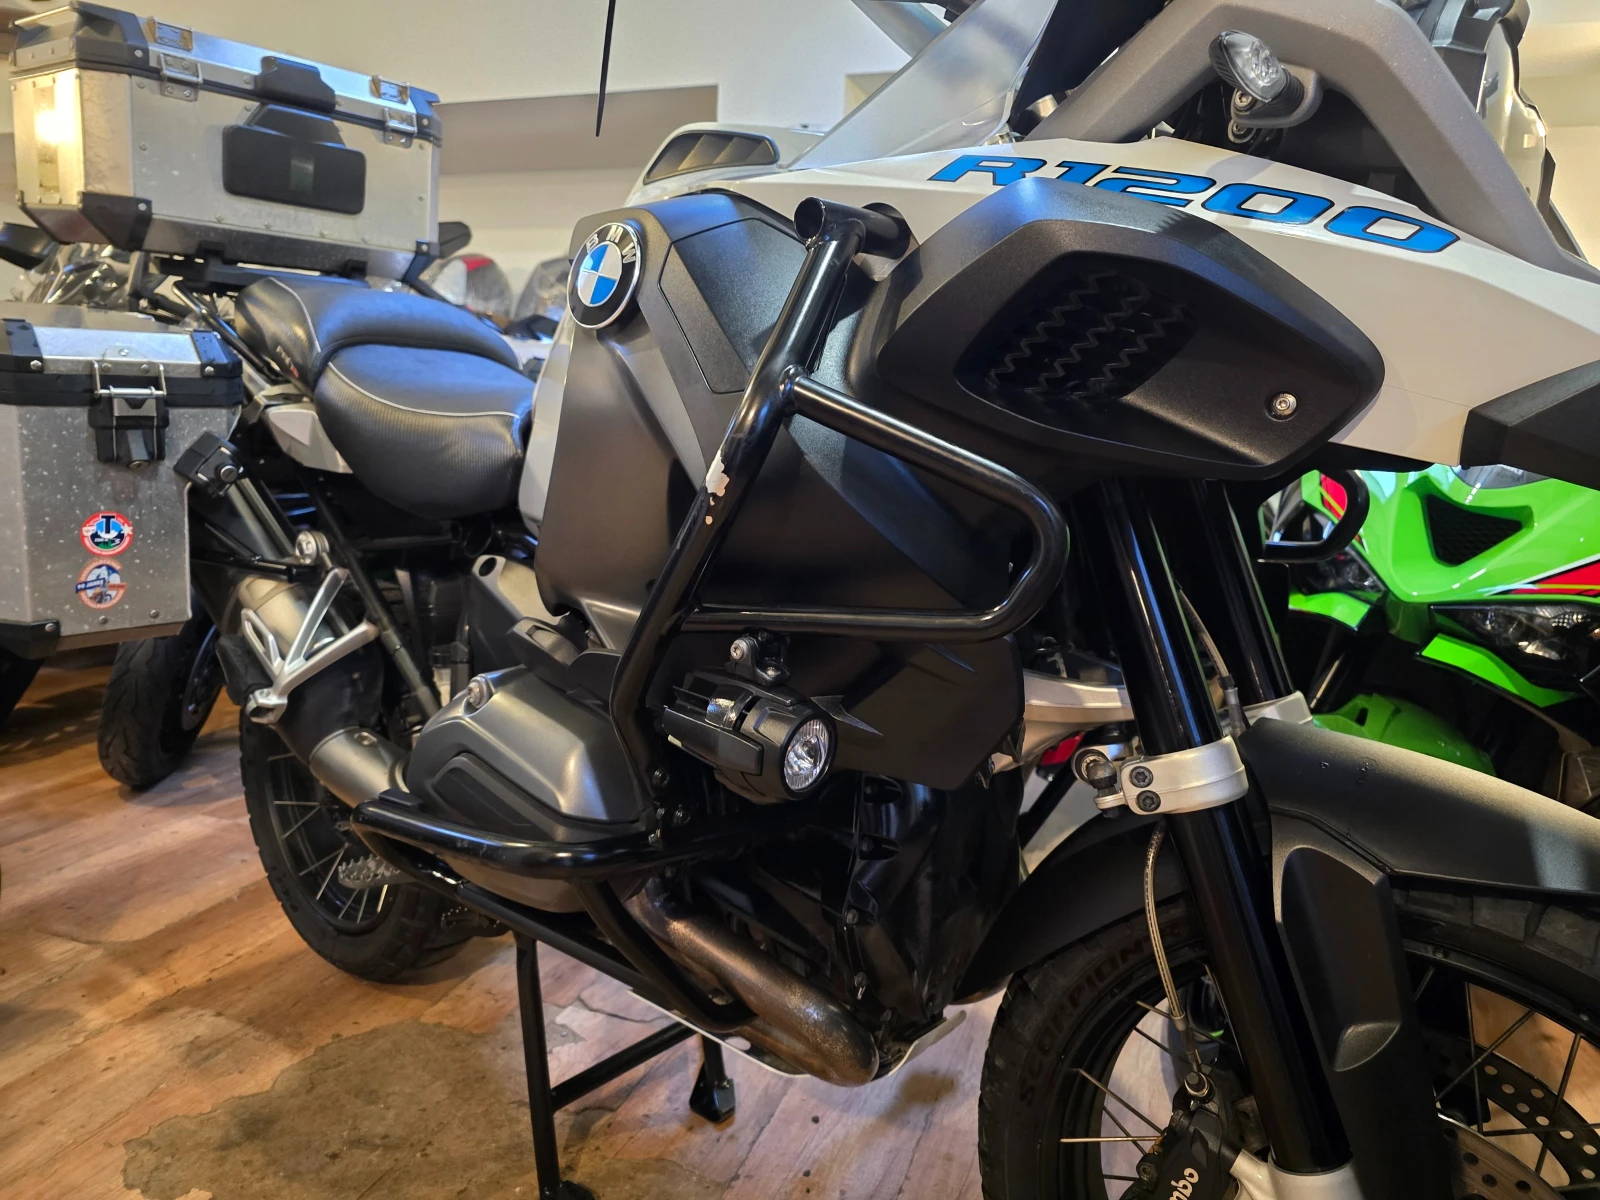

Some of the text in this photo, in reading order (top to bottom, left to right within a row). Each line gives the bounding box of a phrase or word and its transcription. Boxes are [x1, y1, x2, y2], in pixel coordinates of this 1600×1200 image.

[585, 224, 637, 264] BMW
[926, 153, 1461, 254] R1200
[1019, 938, 1145, 1106] SCORPION
